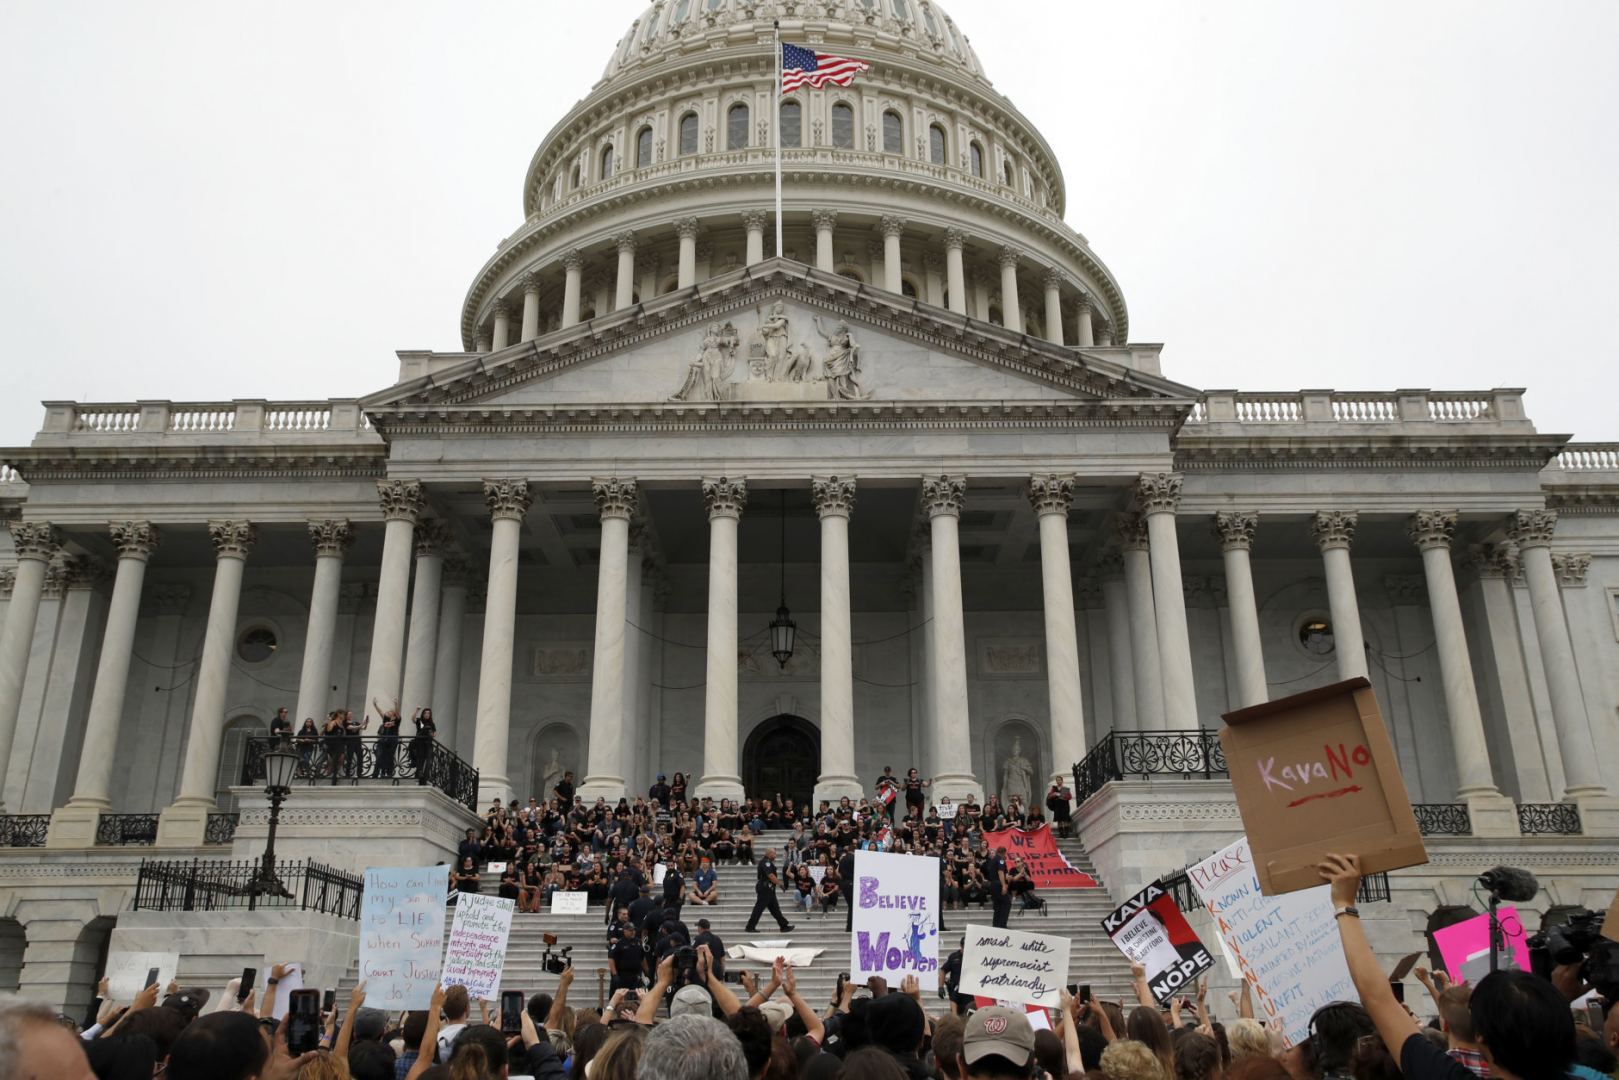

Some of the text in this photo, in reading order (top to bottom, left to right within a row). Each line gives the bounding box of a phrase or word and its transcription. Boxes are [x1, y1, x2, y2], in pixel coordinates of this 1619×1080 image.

[1257, 744, 1370, 793] KavaNo
[1010, 834, 1034, 847] WE
[371, 872, 398, 889] How
[406, 880, 423, 888] can
[371, 895, 395, 913] my
[459, 894, 467, 906] A
[1103, 886, 1163, 932] KAVA
[1206, 884, 1249, 917] KNOWN
[399, 911, 425, 925] LIE
[1123, 919, 1149, 943] BELIEVE
[1133, 926, 1158, 949] CHRISTINE
[1227, 906, 1285, 954] VIOLENT
[368, 935, 400, 949] when
[976, 936, 1055, 954] smash white
[980, 955, 1054, 973] supremacist
[1152, 949, 1210, 1000] NOPE
[980, 973, 1057, 999] patriarchy
[1263, 982, 1304, 1017] UNFIT
[984, 1016, 1007, 1035] W
